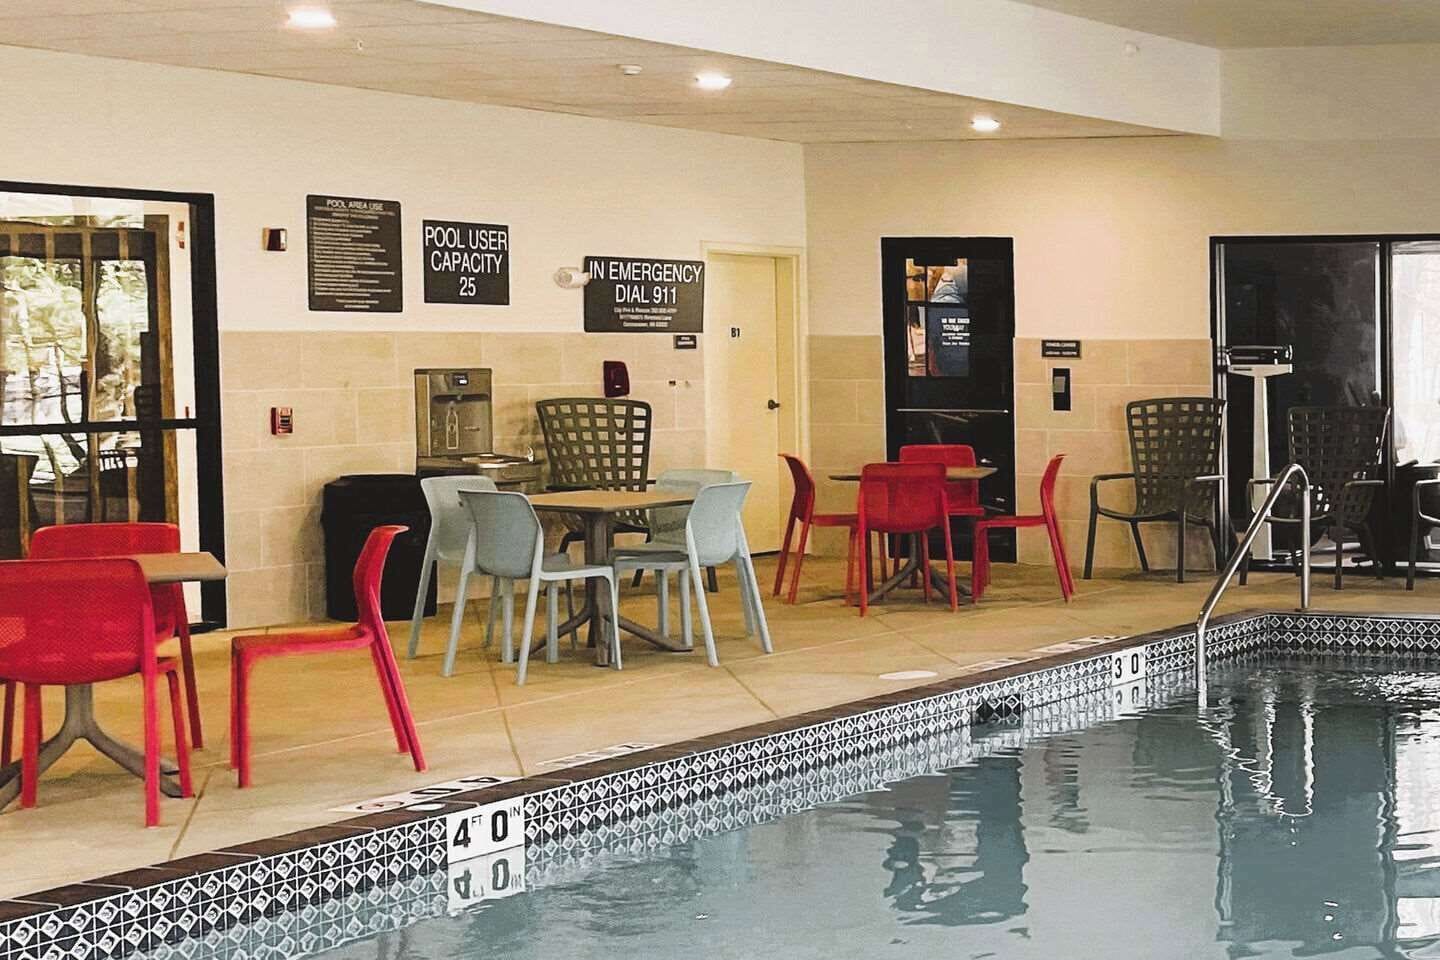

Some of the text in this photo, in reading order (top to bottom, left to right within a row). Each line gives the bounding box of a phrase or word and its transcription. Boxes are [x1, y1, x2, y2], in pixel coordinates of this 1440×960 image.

[425, 226, 508, 251] POOL USER
[431, 250, 502, 273] CAPACITY
[590, 260, 703, 283] IN EMERGENCY
[459, 276, 476, 296] 25
[615, 284, 677, 304] DIAL 911
